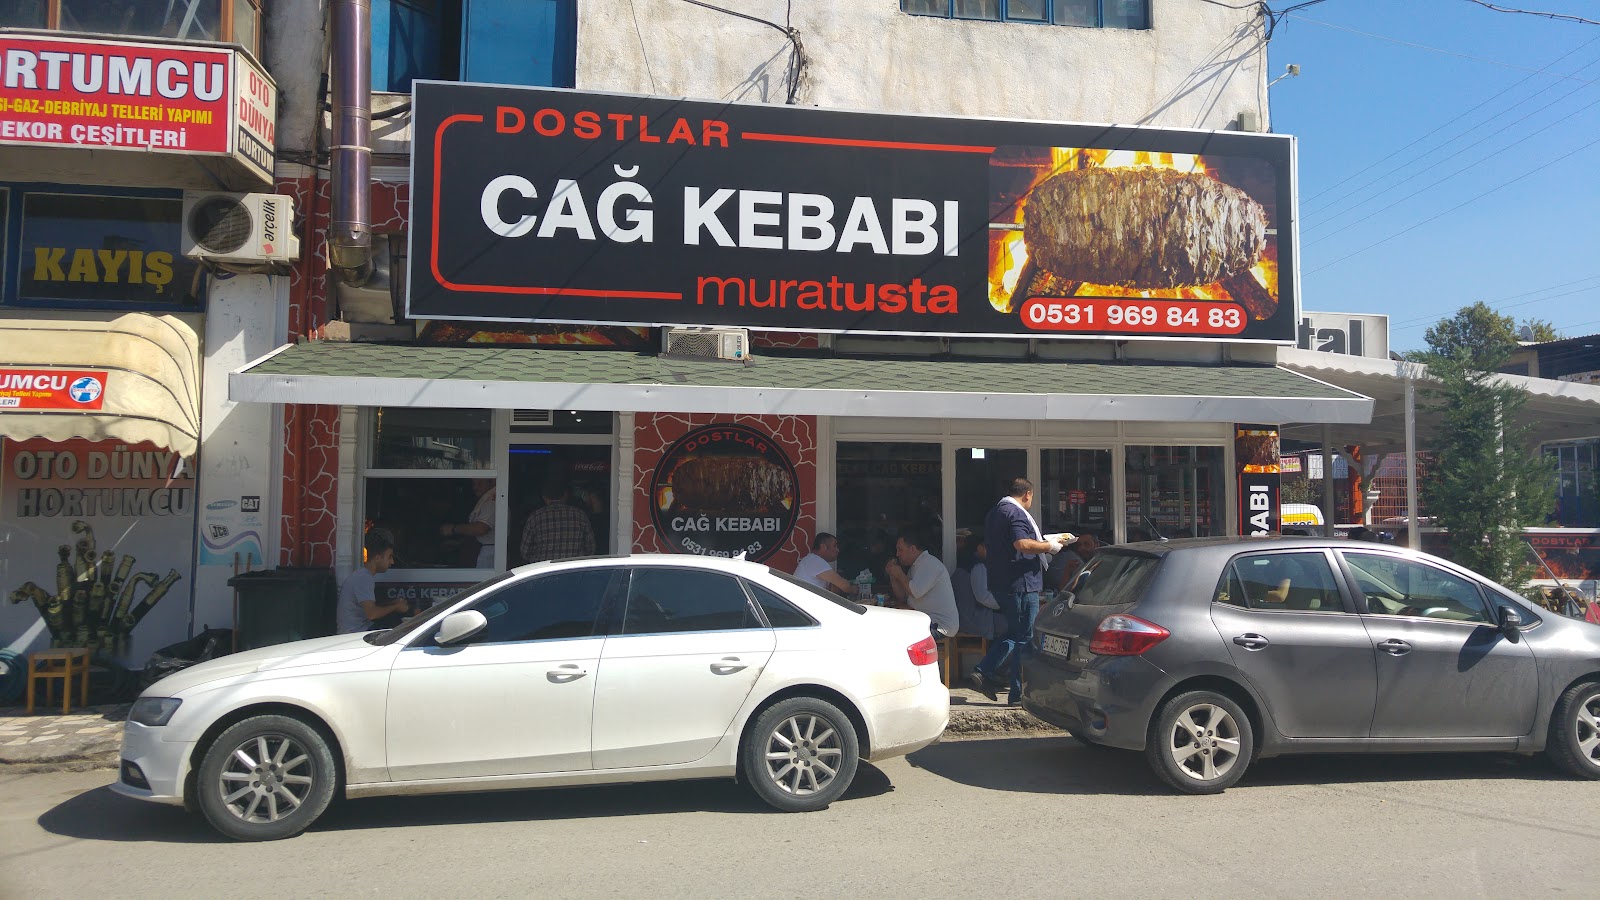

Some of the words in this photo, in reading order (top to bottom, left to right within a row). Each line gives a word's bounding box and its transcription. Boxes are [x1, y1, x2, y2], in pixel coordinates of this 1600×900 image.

[0, 48, 224, 102] RTUMCU
[250, 72, 269, 107] OTO
[112, 103, 163, 121] TELLERİ
[167, 108, 212, 125] YAPIMI
[240, 96, 274, 145] DÜNYA
[496, 106, 729, 147] DOSTLAR
[0, 120, 62, 140] EKOR
[70, 123, 186, 147] ÇEŞİTLERİ
[240, 130, 274, 171] HORTUM
[263, 200, 277, 241] arçelik
[480, 164, 654, 243] CAĞ
[684, 186, 959, 257] KEBABI
[33, 247, 174, 293] KAYIŞ
[697, 275, 959, 313] muratusta
[1029, 303, 1095, 324] 0531
[1107, 304, 1157, 326] 969
[1167, 307, 1199, 327] 84
[1208, 308, 1240, 328] 83
[685, 431, 767, 453] DOSTLAR
[14, 450, 78, 479] OTO
[88, 445, 194, 480] DÜNYA
[17, 488, 190, 517] HORTUMCU
[242, 499, 260, 510] CAT
[212, 526, 229, 538] JCB
[671, 514, 709, 531] CAĞ
[715, 518, 780, 531] KEBABI
[681, 537, 707, 556] 0531
[747, 541, 762, 554] 83
[387, 585, 416, 599] CAĞ
